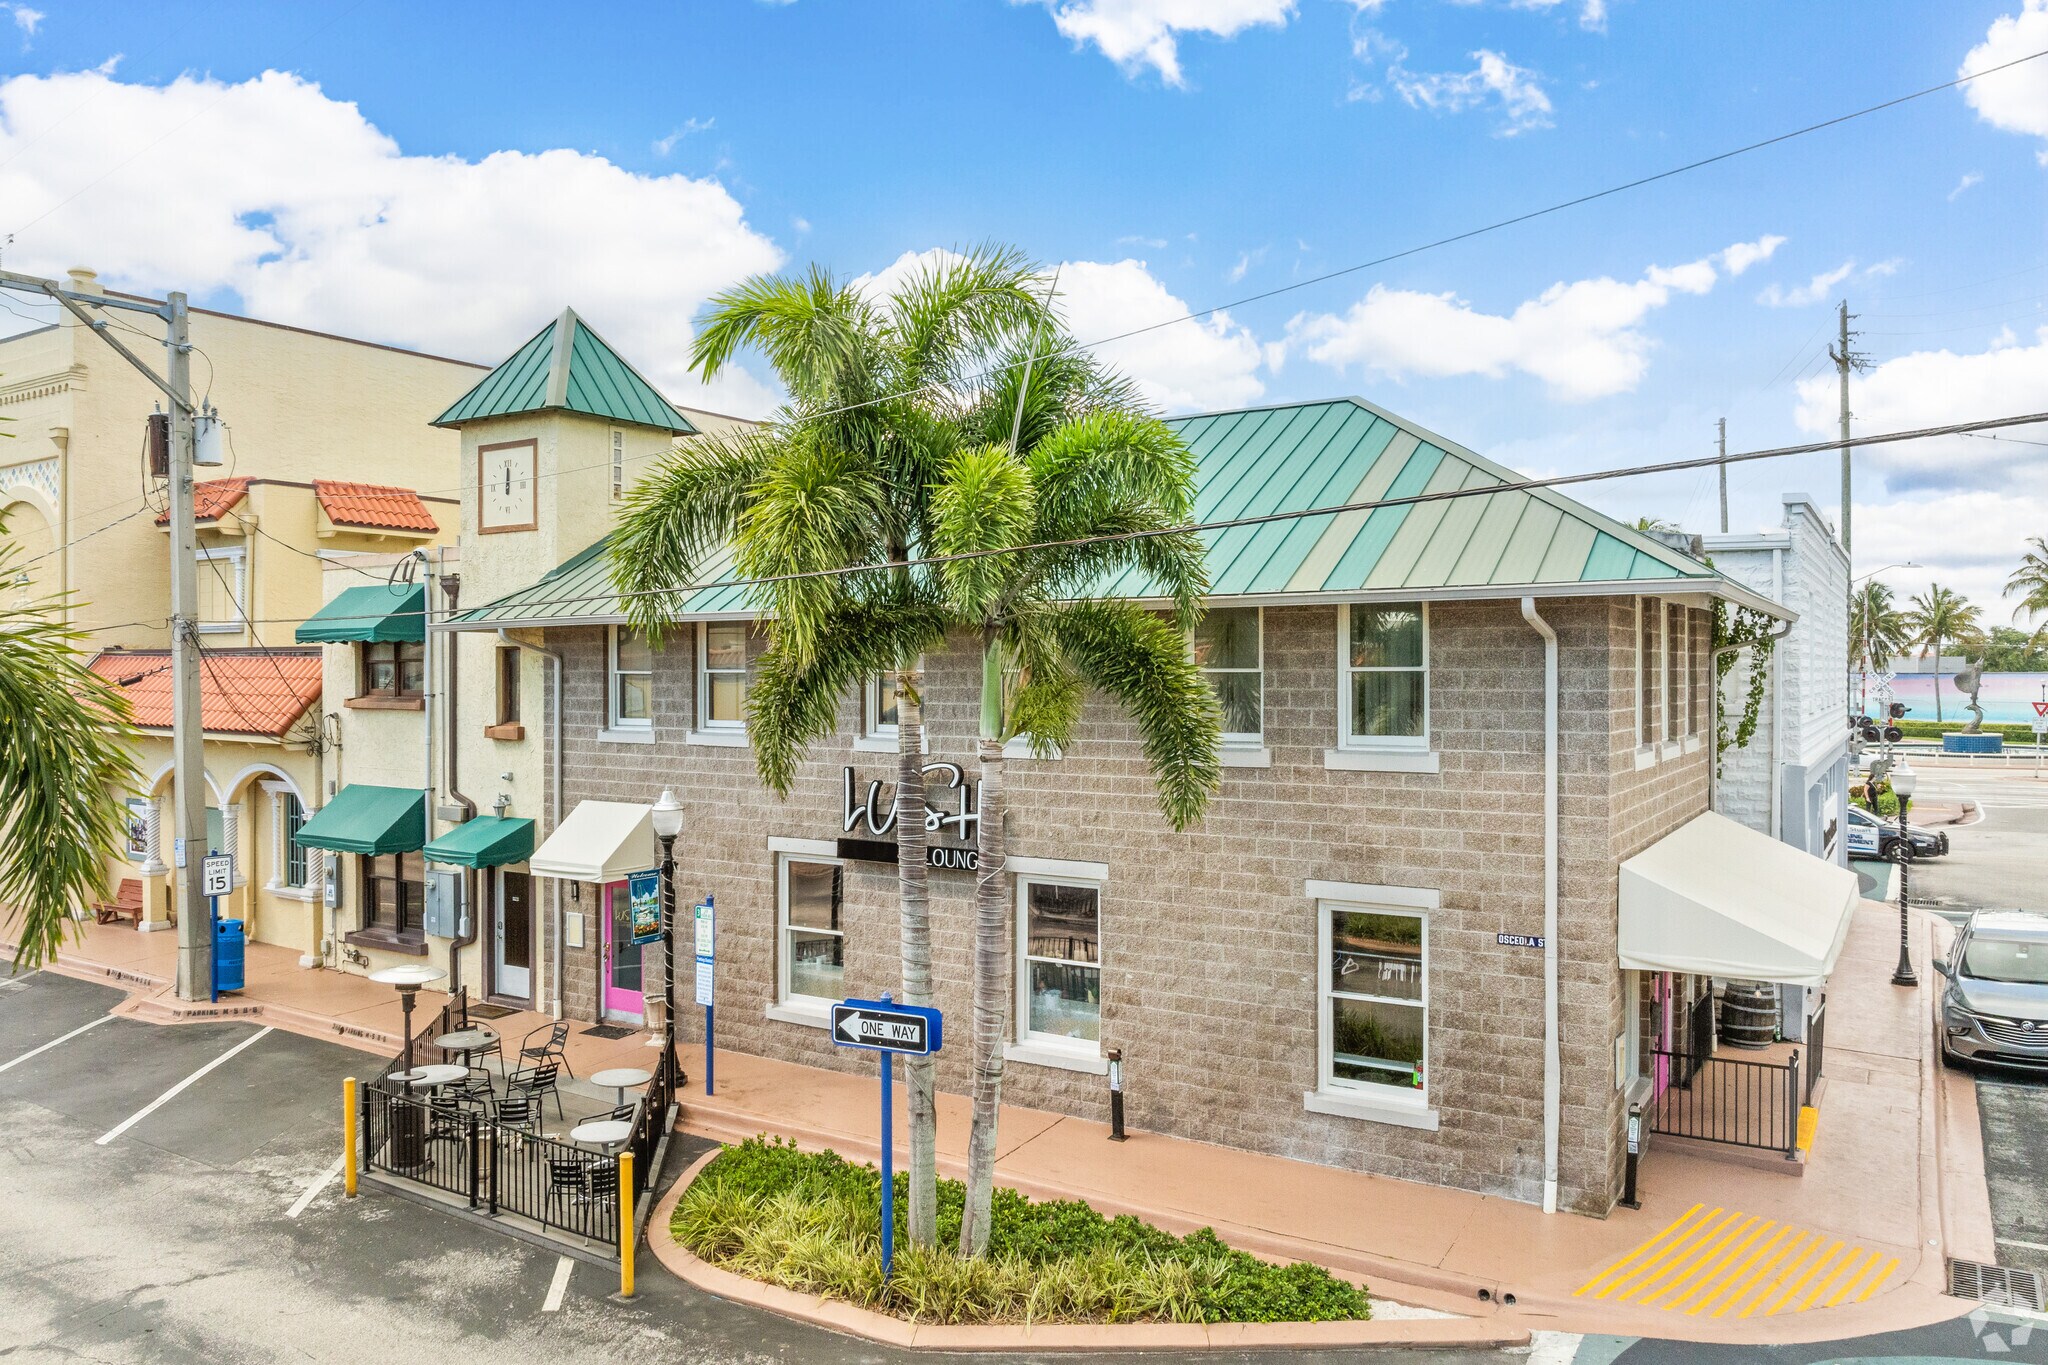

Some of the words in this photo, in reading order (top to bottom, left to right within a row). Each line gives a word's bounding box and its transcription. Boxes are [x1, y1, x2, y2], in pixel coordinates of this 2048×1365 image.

[926, 848, 978, 871] OUNG
[209, 876, 226, 890] 15
[1498, 934, 1535, 947] OSCEOLA
[1537, 938, 1546, 947] S
[187, 1009, 218, 1017] PARKING
[345, 1026, 364, 1038] PARKING
[861, 1020, 884, 1037] ONE
[892, 1024, 916, 1040] WAY
